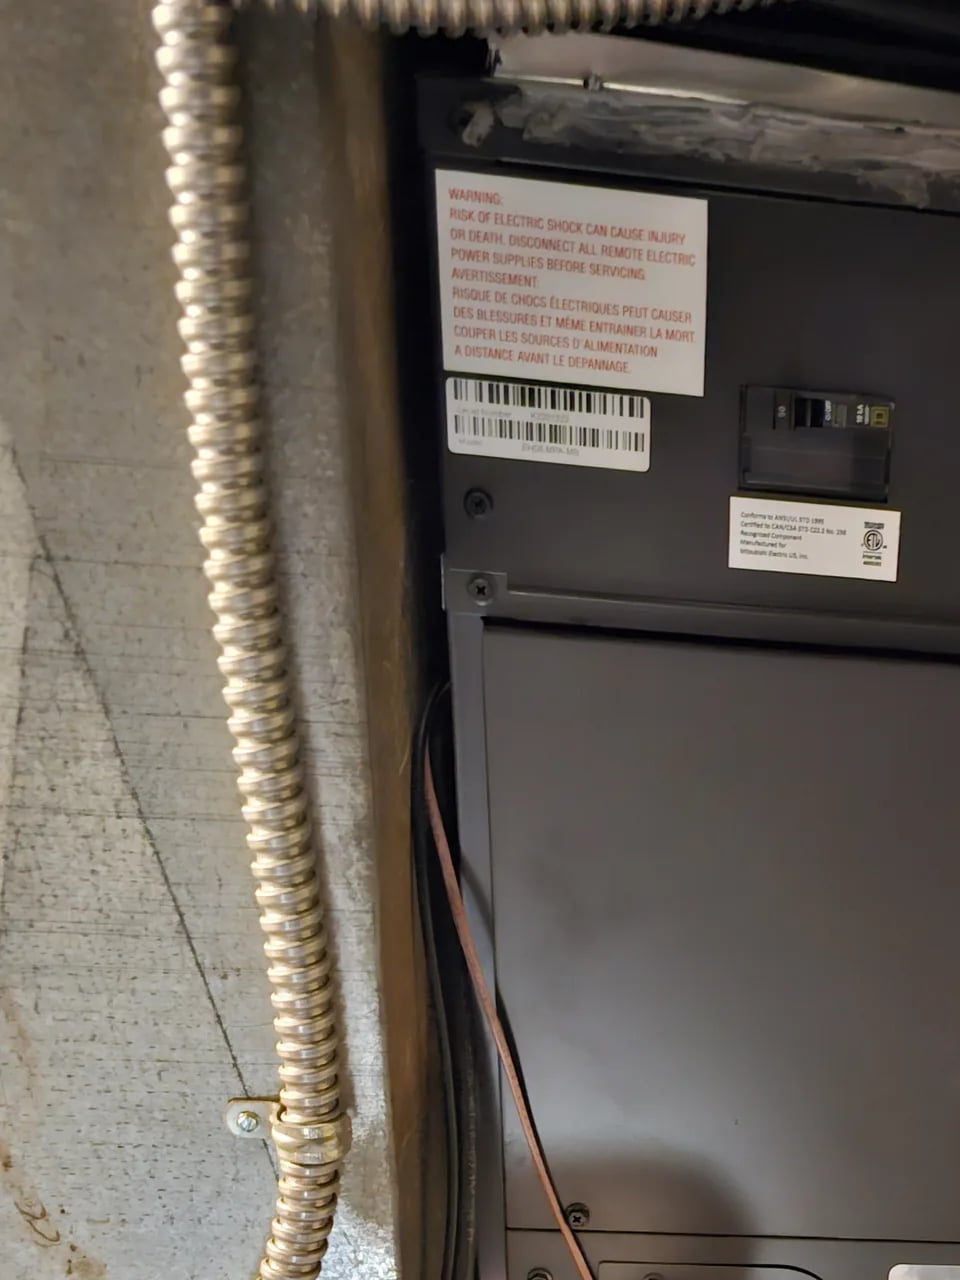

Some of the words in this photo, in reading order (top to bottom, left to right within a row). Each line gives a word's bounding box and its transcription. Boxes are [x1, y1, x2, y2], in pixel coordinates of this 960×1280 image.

[450, 208, 474, 222] RISK
[477, 211, 491, 223] OF
[494, 213, 544, 230] ELECTRIC
[547, 218, 583, 234] SHOCK
[586, 223, 608, 237] CAN
[610, 226, 644, 241] CAUSE
[648, 231, 686, 245] INJURY
[450, 228, 465, 240] OR
[509, 234, 575, 253] DISCONNECT
[579, 242, 597, 256] ALL
[601, 245, 643, 260] REMOTE
[646, 249, 696, 267] ELECTRIC
[451, 246, 489, 263] POWER
[493, 252, 543, 269] SUPPLIES
[547, 258, 584, 274] BEFORE
[452, 286, 491, 303] RISQUE
[494, 291, 508, 304] DE
[511, 293, 546, 308] CHOCS
[549, 294, 619, 316] ÉLECTRIQUES
[622, 305, 649, 319] PEUT
[651, 308, 692, 324] CAUSER
[453, 306, 474, 319] DES
[477, 308, 537, 326] BLESSURES
[540, 315, 552, 327] ET
[650, 327, 662, 339] LA
[454, 325, 496, 340] COUPER
[499, 330, 518, 343] LES
[520, 332, 570, 348] SOURCES
[584, 338, 658, 358] ALIMENTATION
[464, 345, 513, 361] DISTANCE
[518, 351, 550, 364] AVANT
[553, 354, 565, 366] LE
[740, 512, 766, 520] Conforms
[740, 530, 770, 539] Recognized
[771, 532, 802, 541] Component
[740, 539, 777, 548] Manufactured
